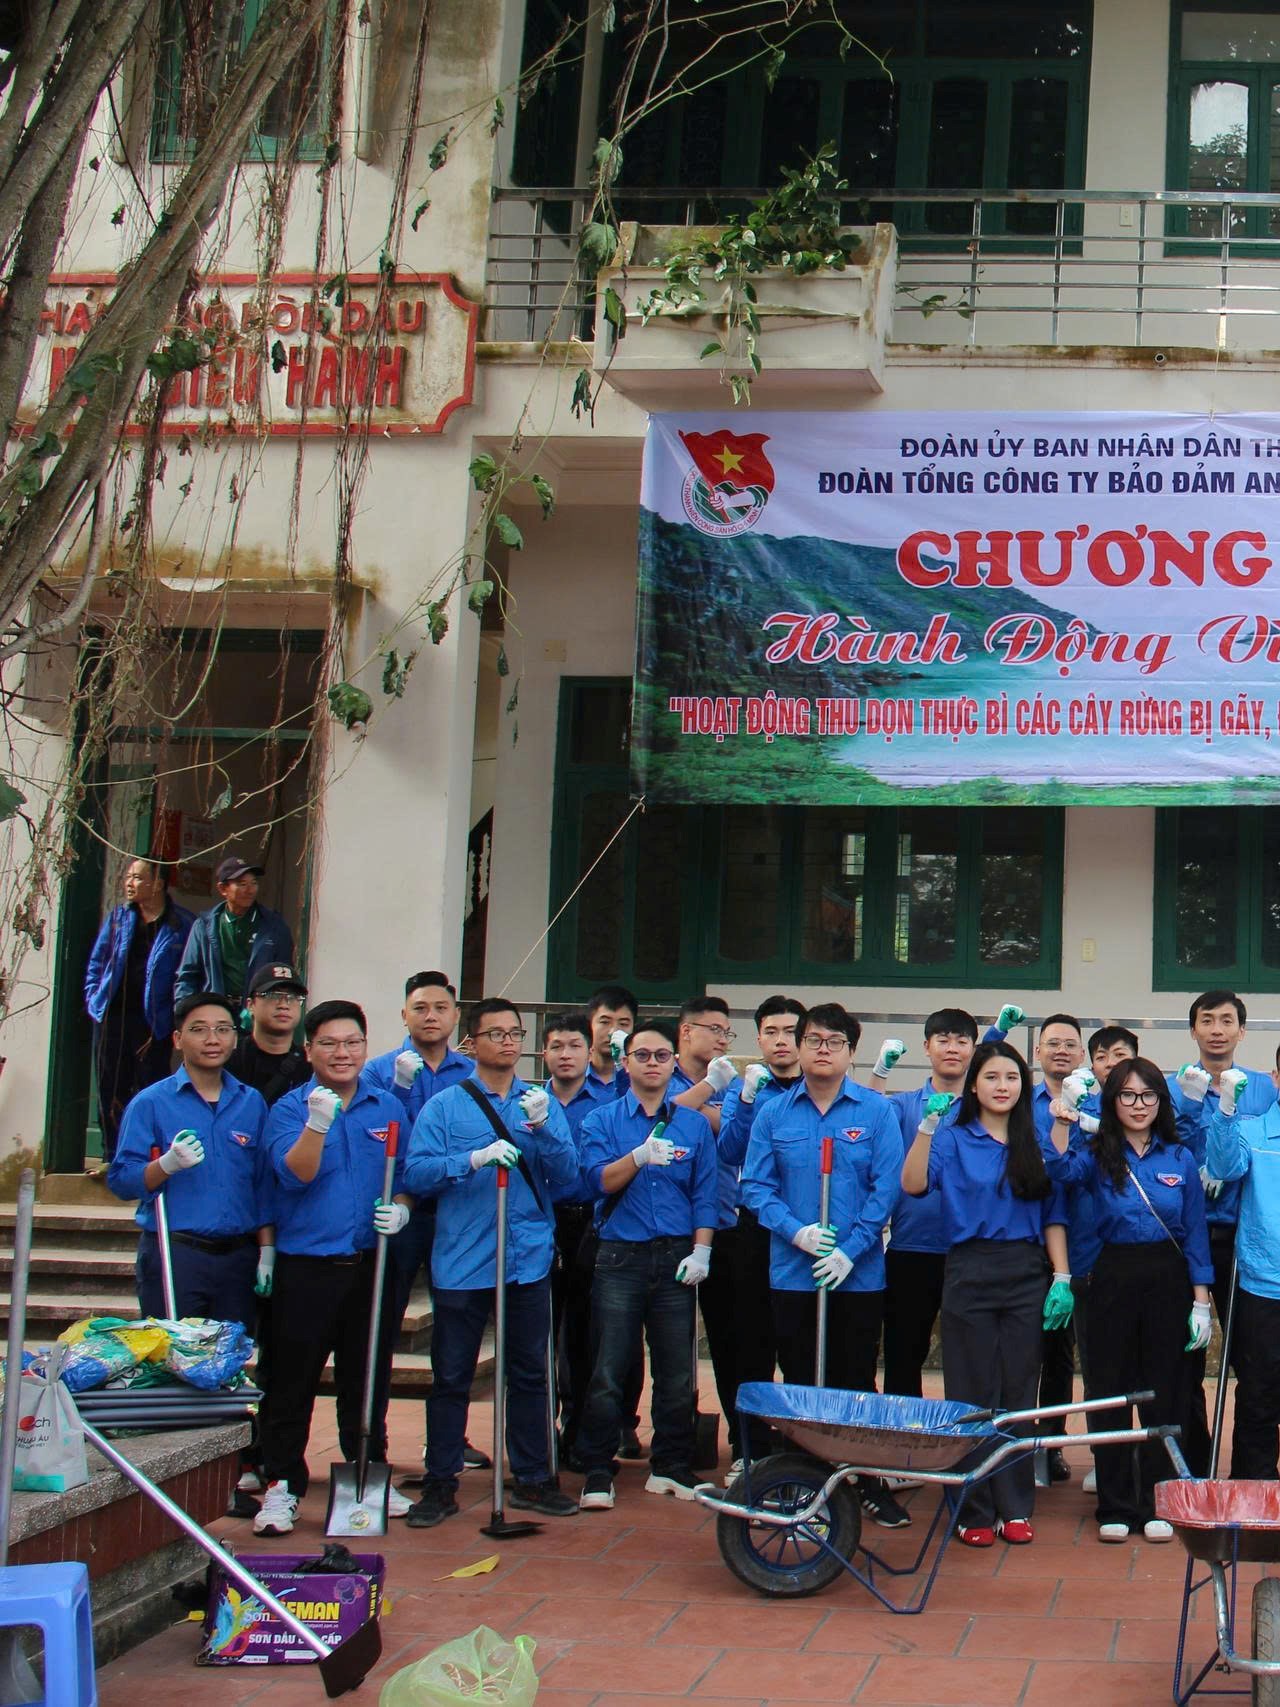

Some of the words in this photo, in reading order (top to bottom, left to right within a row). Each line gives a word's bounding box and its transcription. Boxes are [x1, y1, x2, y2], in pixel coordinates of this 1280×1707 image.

[900, 432, 978, 458] ĐOÀN
[988, 429, 1024, 458] ỦY
[1033, 438, 1088, 457] BAN
[1098, 432, 1174, 458] NHÂN
[1183, 432, 1241, 458] DÂN
[818, 468, 893, 494] ĐOÀN
[902, 463, 974, 494] TỔNG
[983, 467, 1058, 494] CÔNG
[1068, 471, 1099, 493] TY
[1108, 462, 1163, 494] BẢO
[1172, 462, 1235, 494] ĐẢM
[898, 524, 1272, 588] CHƯƠNG
[762, 612, 968, 664] Hành
[984, 612, 1178, 677] Động
[669, 696, 742, 743] "HOẠT
[746, 689, 810, 743] ĐỘNG
[816, 698, 859, 735] THU
[866, 698, 913, 743] DỌN
[921, 695, 979, 743] THỰC
[985, 691, 1008, 735] BÌ
[1015, 691, 1061, 736] CÁC
[1068, 691, 1113, 736] CÂY
[1119, 690, 1182, 736] RỪNG
[1189, 699, 1212, 743] BỊ
[1219, 692, 1271, 741] GÃY,
